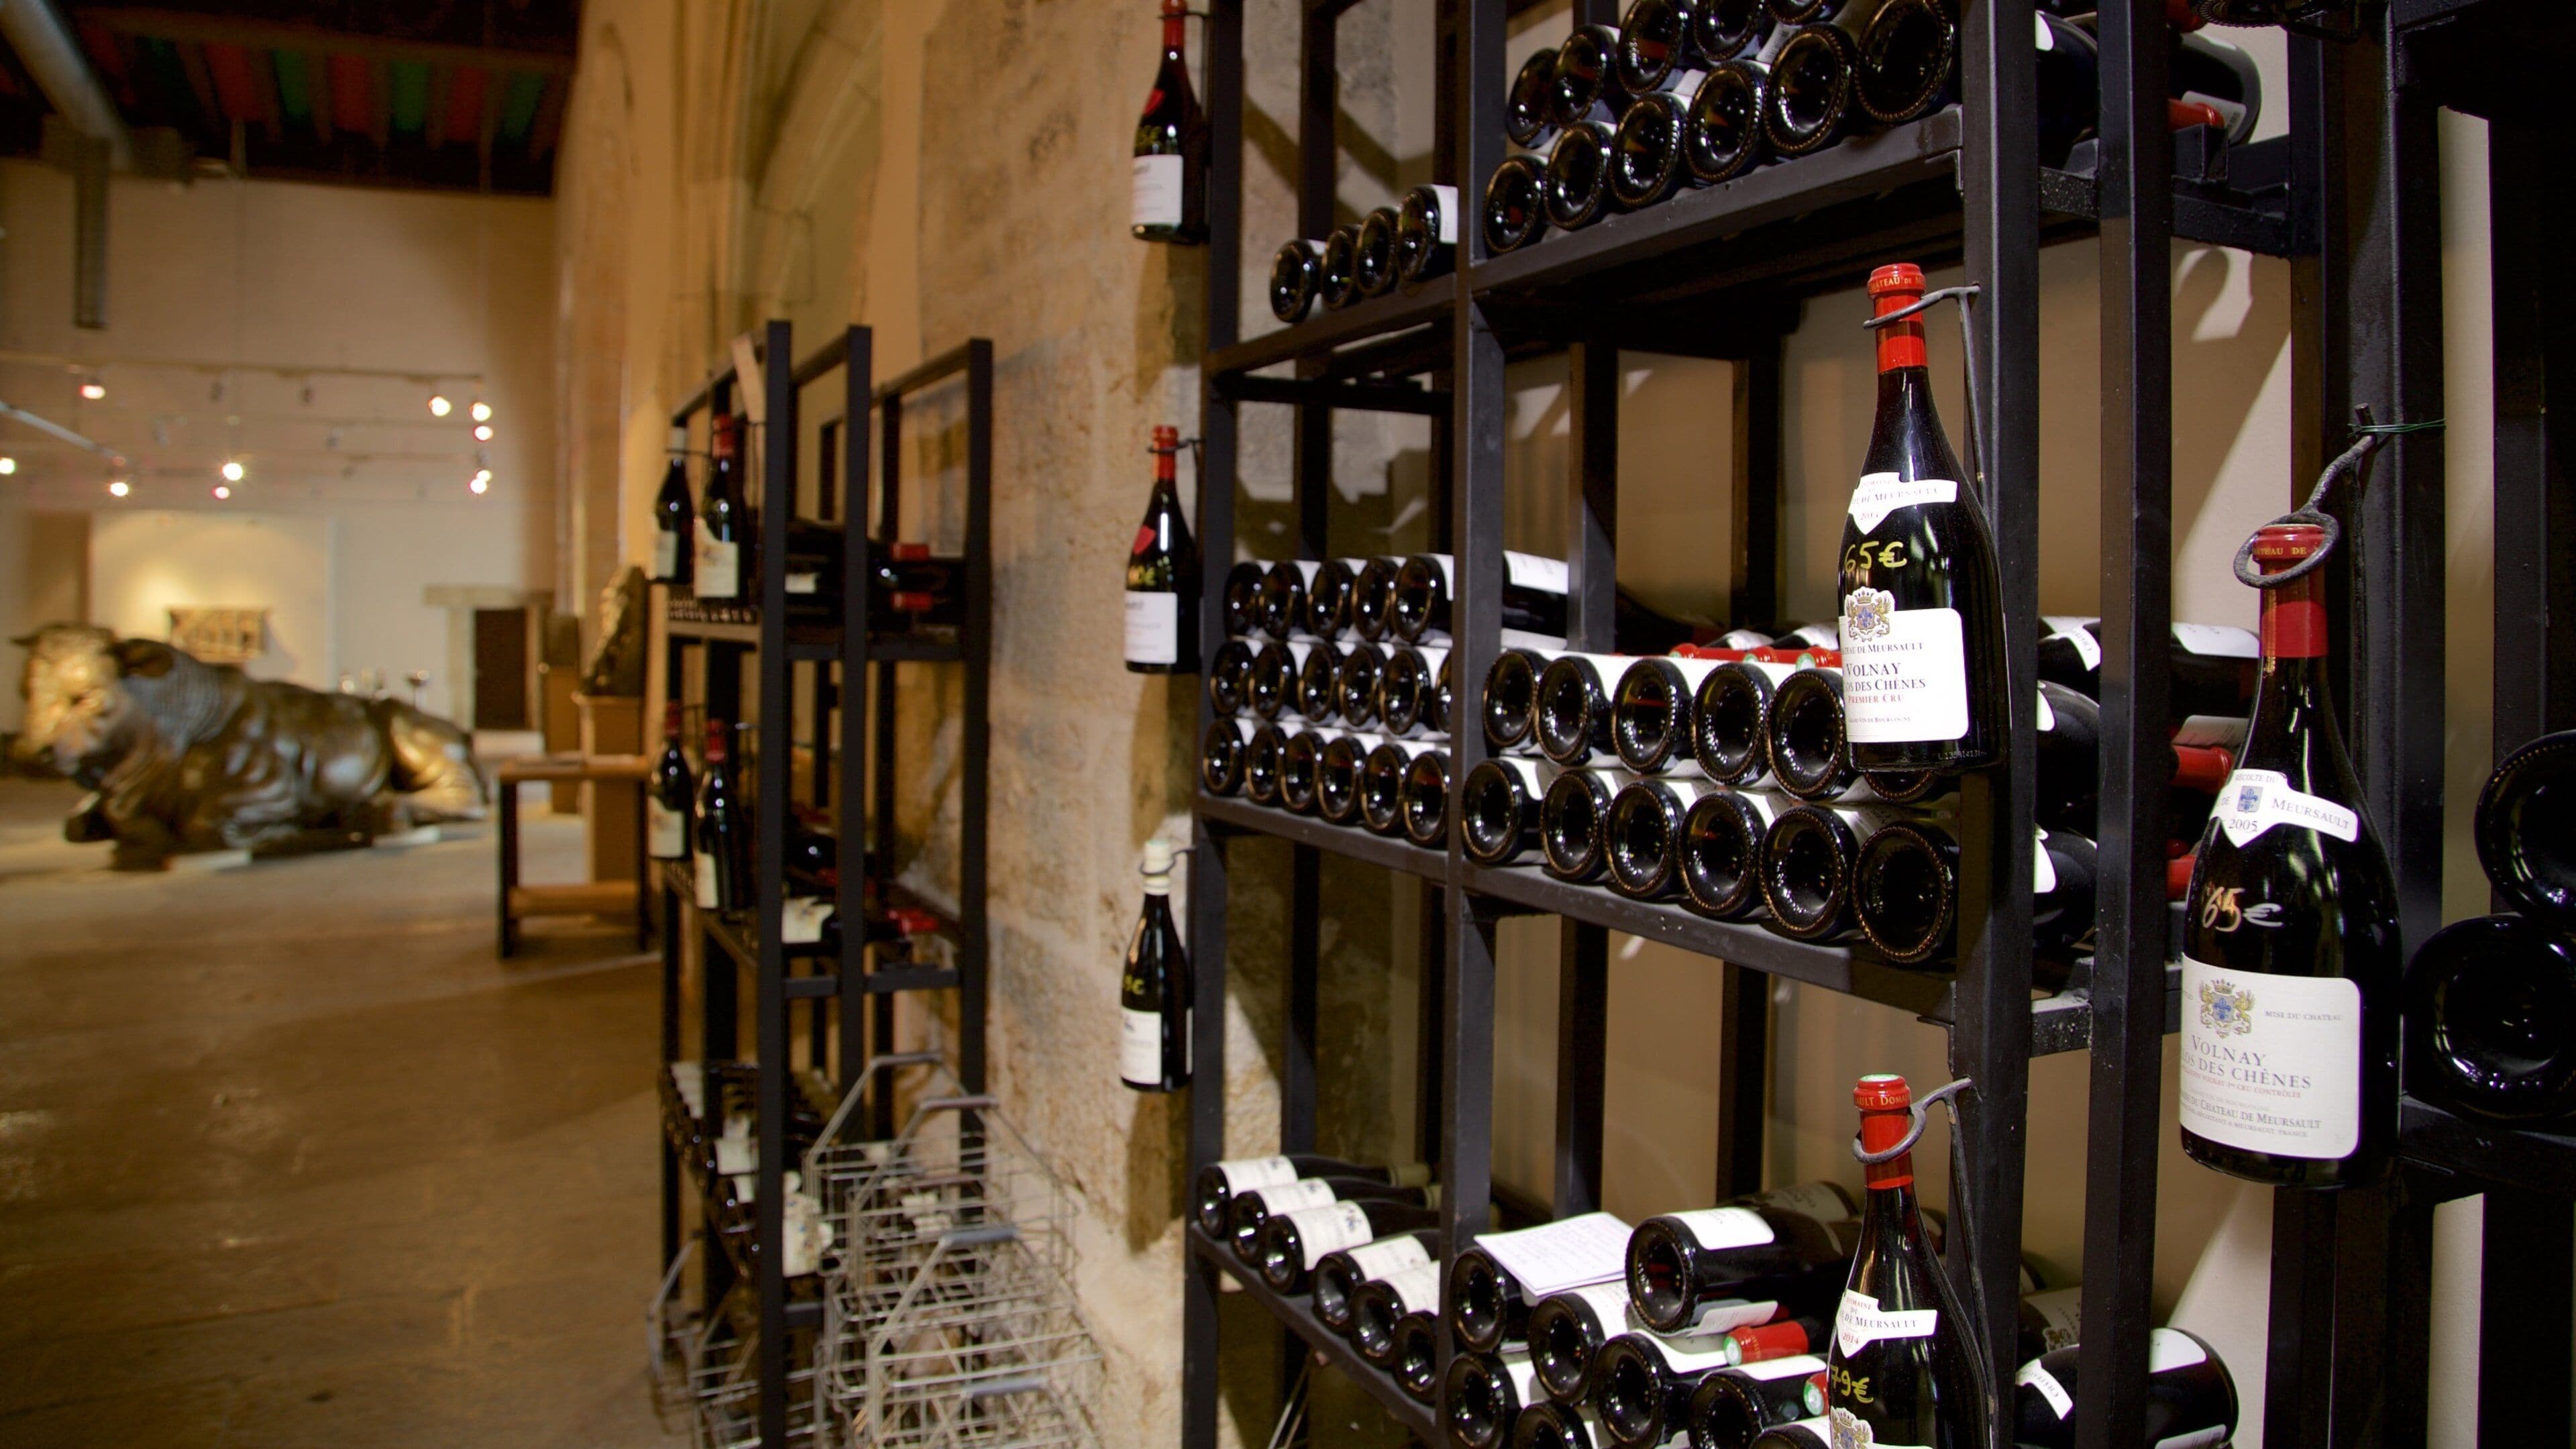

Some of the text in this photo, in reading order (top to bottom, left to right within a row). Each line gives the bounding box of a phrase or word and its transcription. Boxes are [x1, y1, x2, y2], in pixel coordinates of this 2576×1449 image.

[2253, 547, 2307, 555] ATEAU DE
[1857, 645, 1866, 653] DE
[1868, 642, 1923, 653] MEURSAULT
[1845, 663, 1901, 677] VOLNAY
[1855, 682, 1872, 692] DES
[1874, 678, 1927, 691] CHÊNES
[1847, 694, 1904, 704] PREMIER CRU
[2220, 796, 2351, 830] DE MEURSAULT
[2229, 818, 2258, 833] 2005
[2191, 1034, 2266, 1068] VOLNAY
[2198, 1057, 2225, 1077] DES
[2231, 1068, 2312, 1089] CHÊNES
[2241, 1111, 2254, 1122] DE
[2257, 1113, 2321, 1129] MEURSAULT
[1856, 1316, 1917, 1328] MEURSAULT
[1842, 1332, 1859, 1344] 2014
